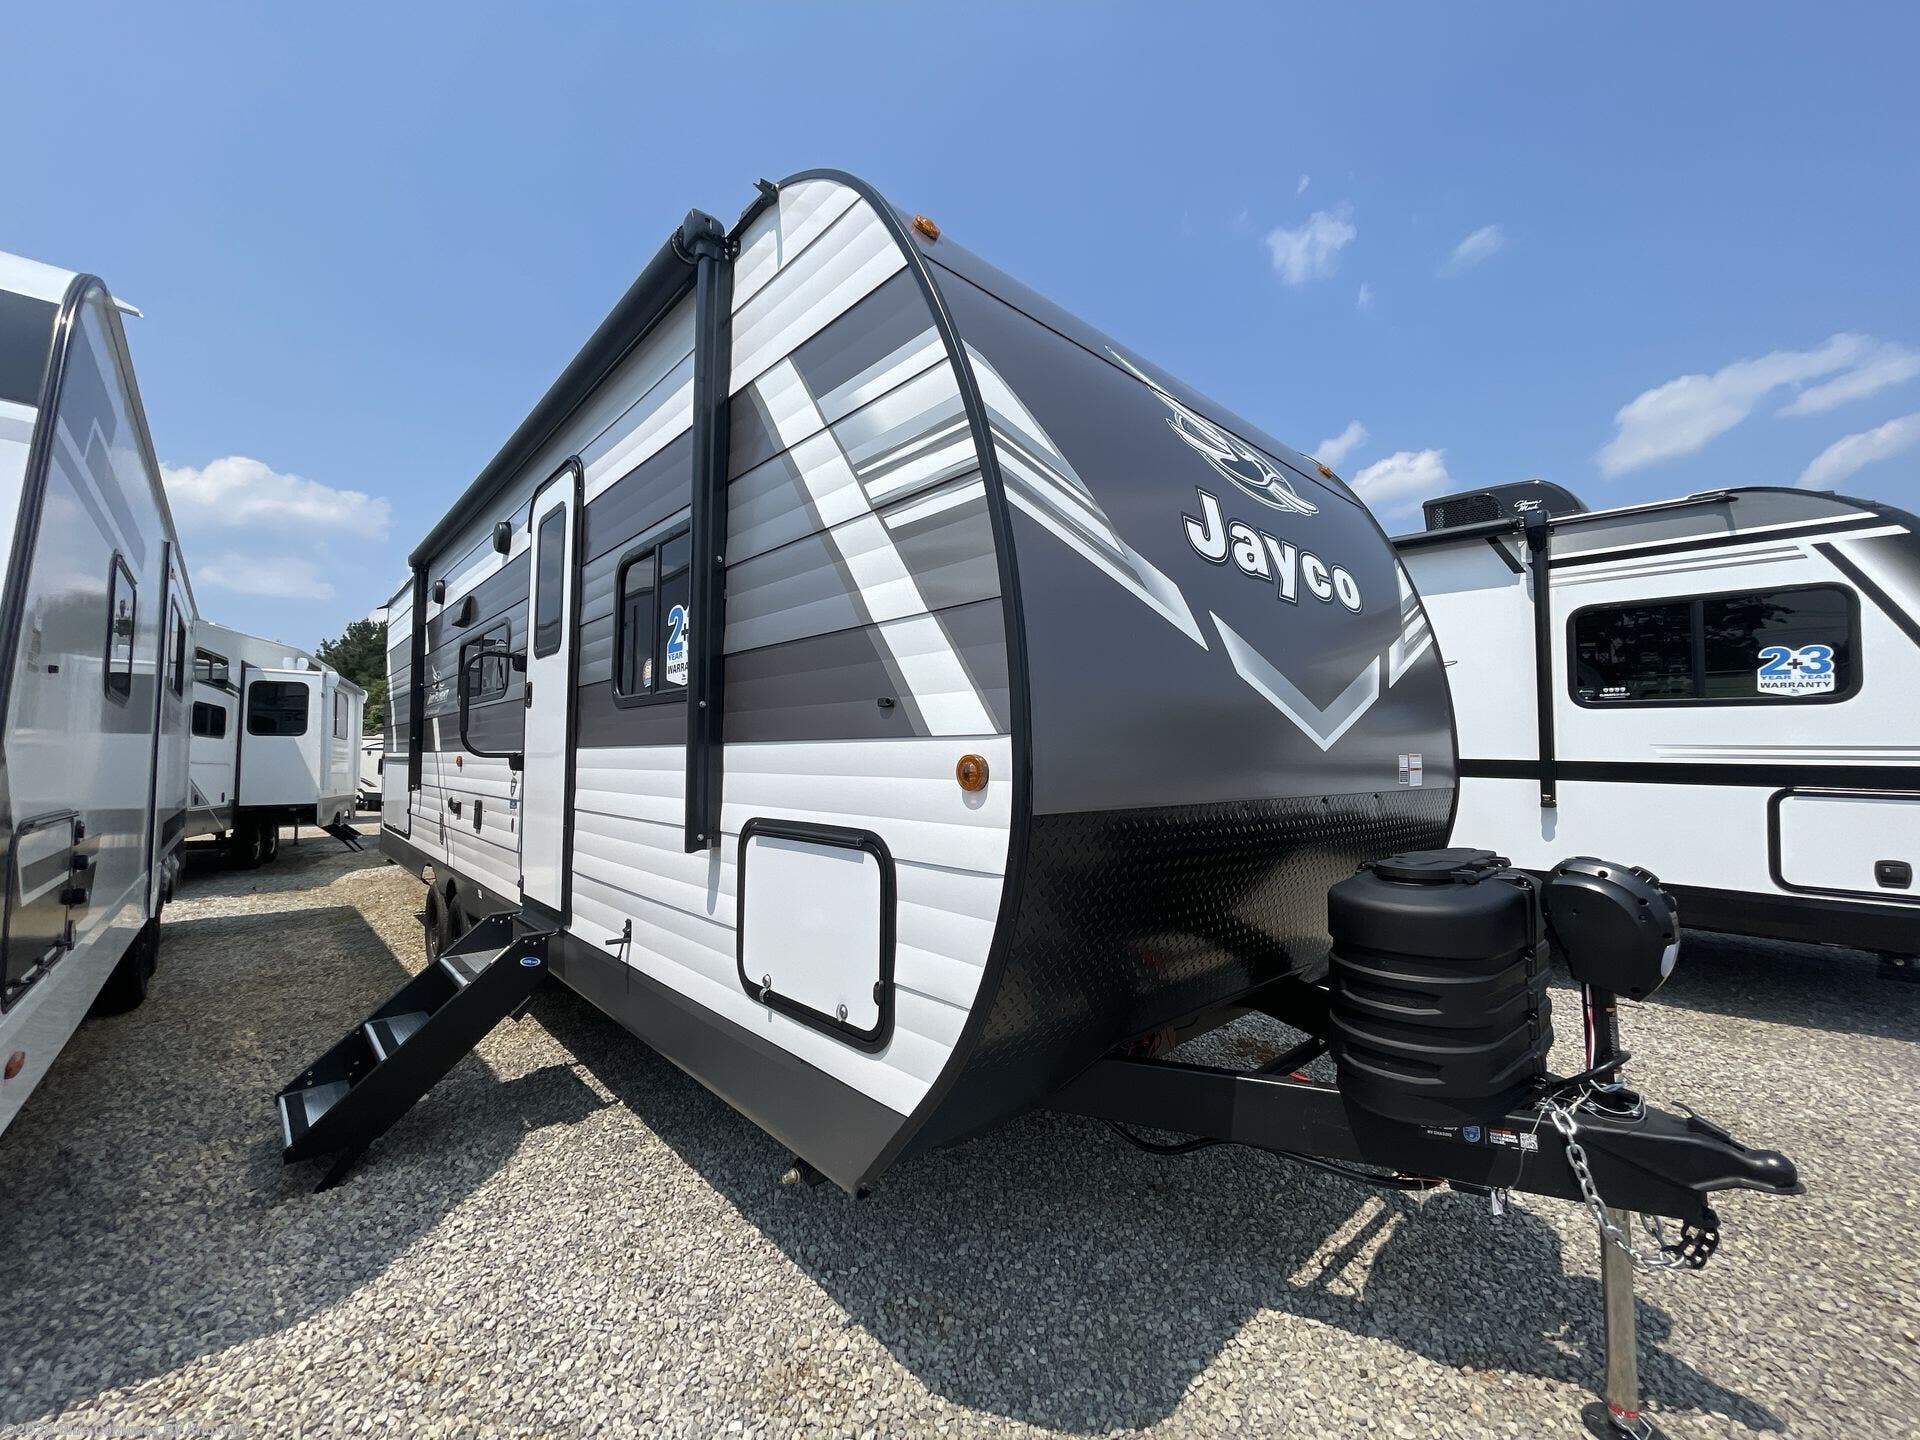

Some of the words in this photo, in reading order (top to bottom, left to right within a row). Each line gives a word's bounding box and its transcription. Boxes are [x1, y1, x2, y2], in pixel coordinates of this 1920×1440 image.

[1183, 488, 1363, 613] Jayco
[668, 652, 683, 661] YEAR
[1760, 645, 1832, 676] 2+3
[667, 662, 688, 675] WARRA
[1760, 681, 1831, 689] WARRANTY
